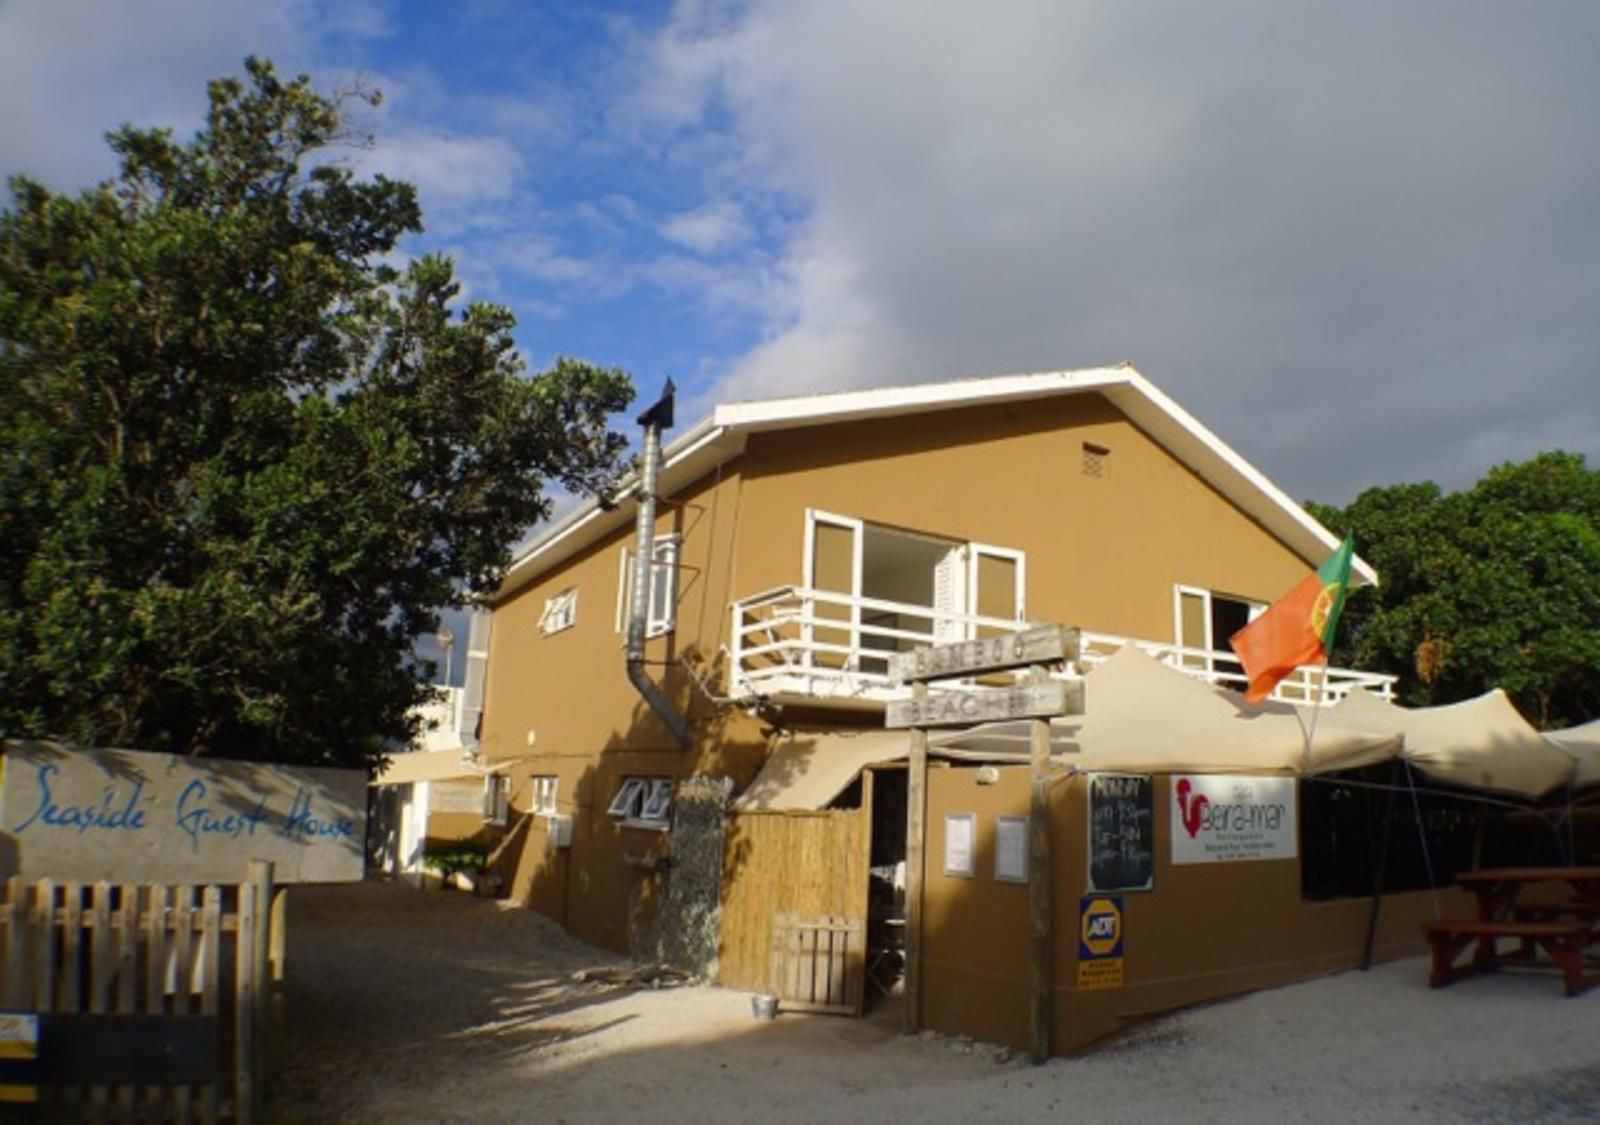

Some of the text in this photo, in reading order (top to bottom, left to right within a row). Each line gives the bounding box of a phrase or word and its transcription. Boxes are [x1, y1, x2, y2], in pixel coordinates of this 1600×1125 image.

[15, 765, 354, 849] Seaside Guest House
[1088, 916, 1116, 936] ADT
